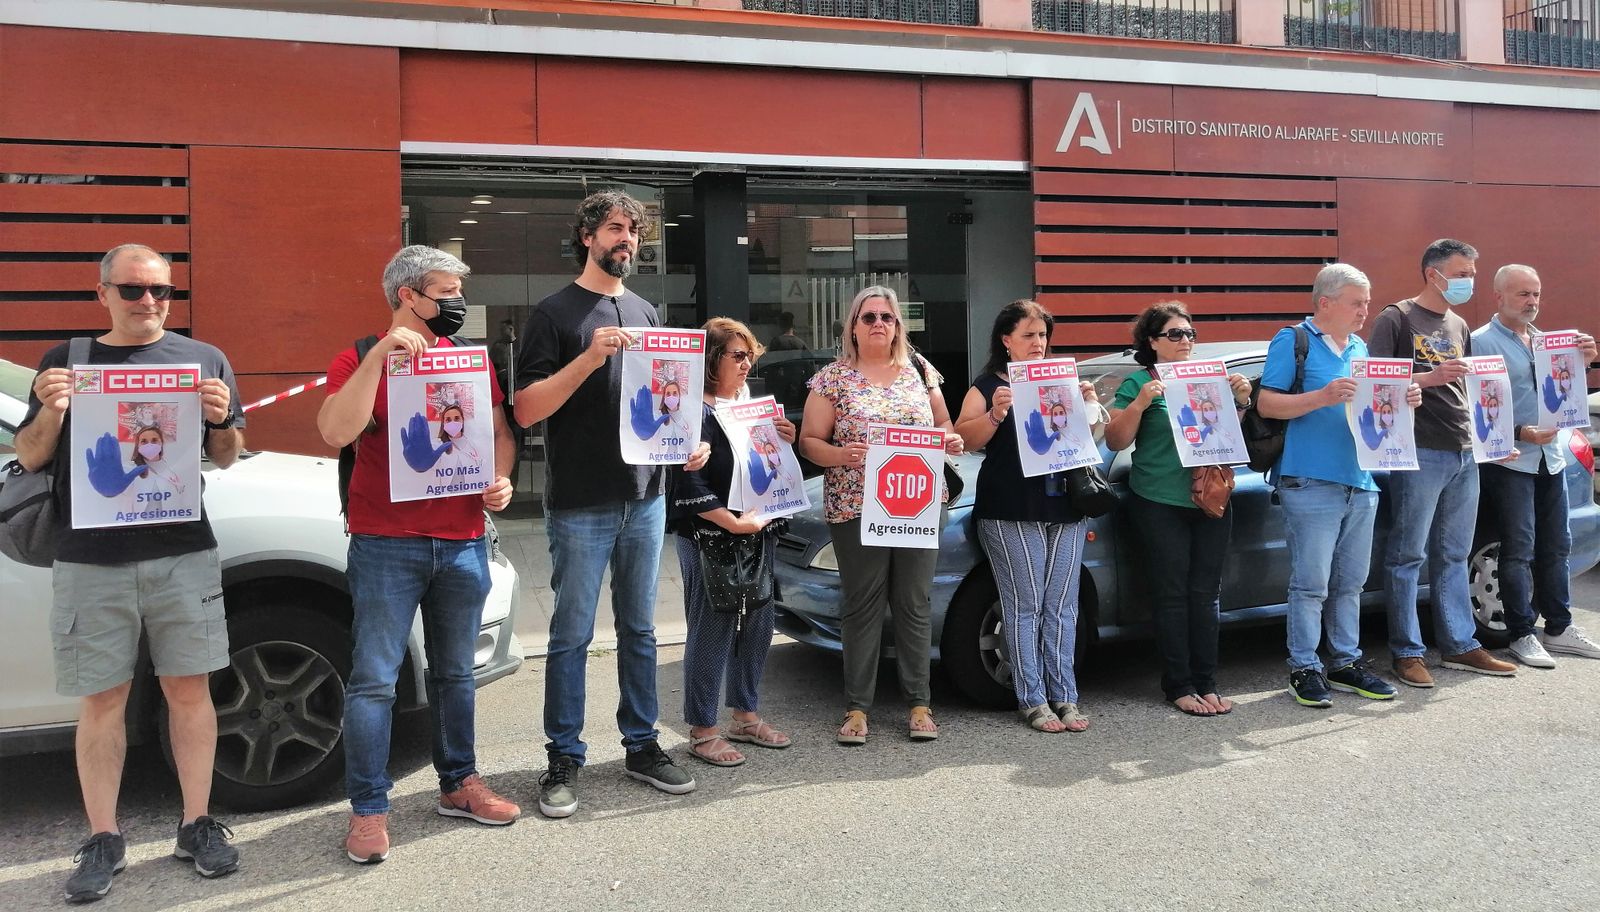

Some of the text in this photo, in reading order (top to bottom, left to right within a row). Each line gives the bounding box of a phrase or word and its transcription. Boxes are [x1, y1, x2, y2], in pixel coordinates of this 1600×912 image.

[1131, 118, 1197, 136] DISTRITO
[1199, 121, 1271, 140] SANITARIO
[1274, 125, 1339, 142] ALJARAFE
[1350, 128, 1400, 144] SEVILLA
[1401, 131, 1444, 146] NORTE
[648, 336, 690, 349] CCOO
[1546, 336, 1574, 347] CCOO
[418, 355, 471, 371] CCOO
[1369, 364, 1401, 375] CCOO
[1031, 365, 1068, 378] CCOO
[1176, 364, 1215, 376] CCOO
[109, 374, 177, 389] CCOO
[1563, 408, 1578, 416] STOP
[661, 437, 684, 446] STOP
[889, 431, 931, 445] CCOO
[1186, 431, 1199, 439] STOP
[649, 452, 691, 462] Agresion
[1057, 448, 1079, 457] STOP
[1192, 447, 1234, 457] Agresiones
[1385, 448, 1402, 456] STOP
[1048, 456, 1097, 471] Agresiones
[435, 465, 480, 478] NO Más
[426, 480, 490, 496] Agresiones
[772, 487, 790, 498] STOP
[885, 473, 927, 499] STOP
[136, 491, 172, 503] STOP
[764, 499, 803, 513] Agresiones
[115, 508, 192, 523] Agresiones
[868, 522, 936, 537] Agresiones
